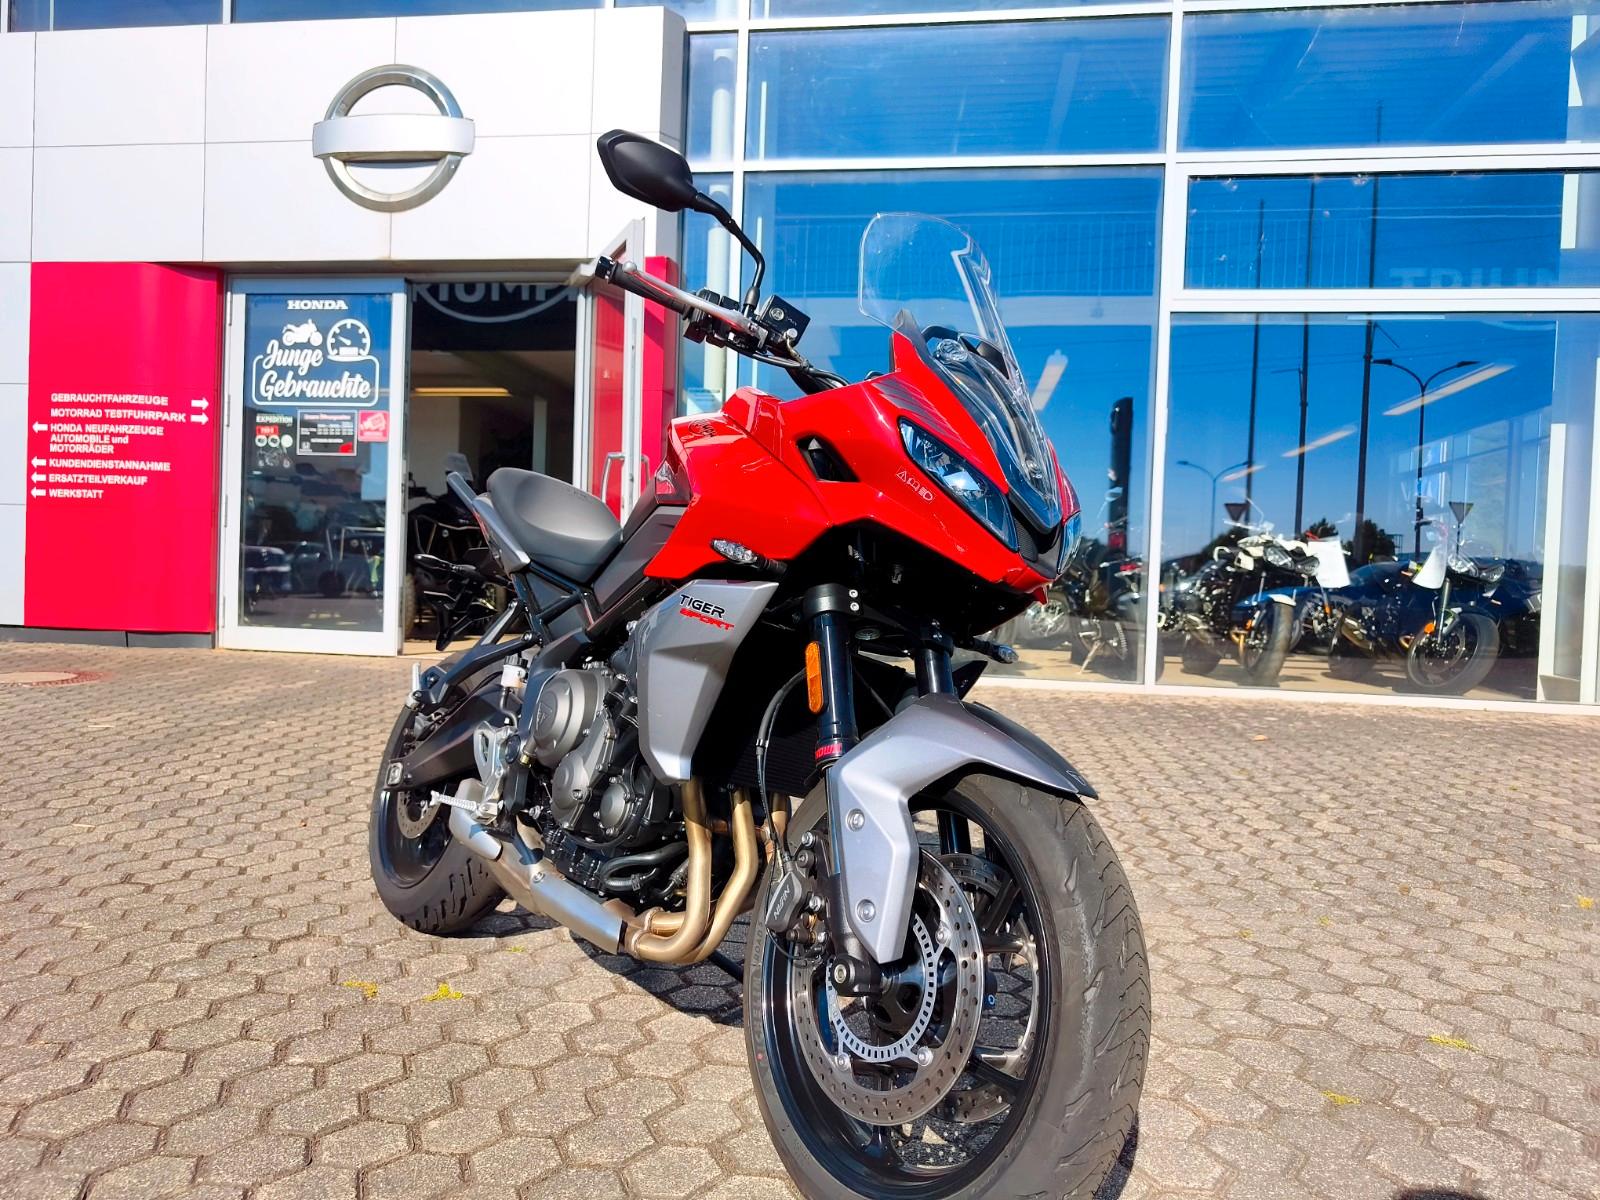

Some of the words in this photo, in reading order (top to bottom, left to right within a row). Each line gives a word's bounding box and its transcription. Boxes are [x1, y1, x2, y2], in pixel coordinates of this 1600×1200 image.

[287, 299, 348, 310] HONDA
[262, 339, 323, 376] Junge
[259, 370, 371, 401] Gebrauchte
[51, 393, 169, 406] GEBRAUCHTFAHRZEUGE
[51, 408, 102, 418] MOTORRAD
[104, 409, 186, 422] TESTFUHRPARK
[50, 423, 82, 433] HONDA
[85, 424, 164, 435] NEUFAHRZEUGE
[50, 434, 110, 444] AUTOMOBILE
[111, 435, 129, 444] und
[49, 458, 171, 471] KUNDENDIENSTANNAHME
[49, 474, 148, 485] ERSATZTEILVERKAUF
[49, 489, 104, 498] WERKSTATT
[680, 594, 725, 619] TIGER
